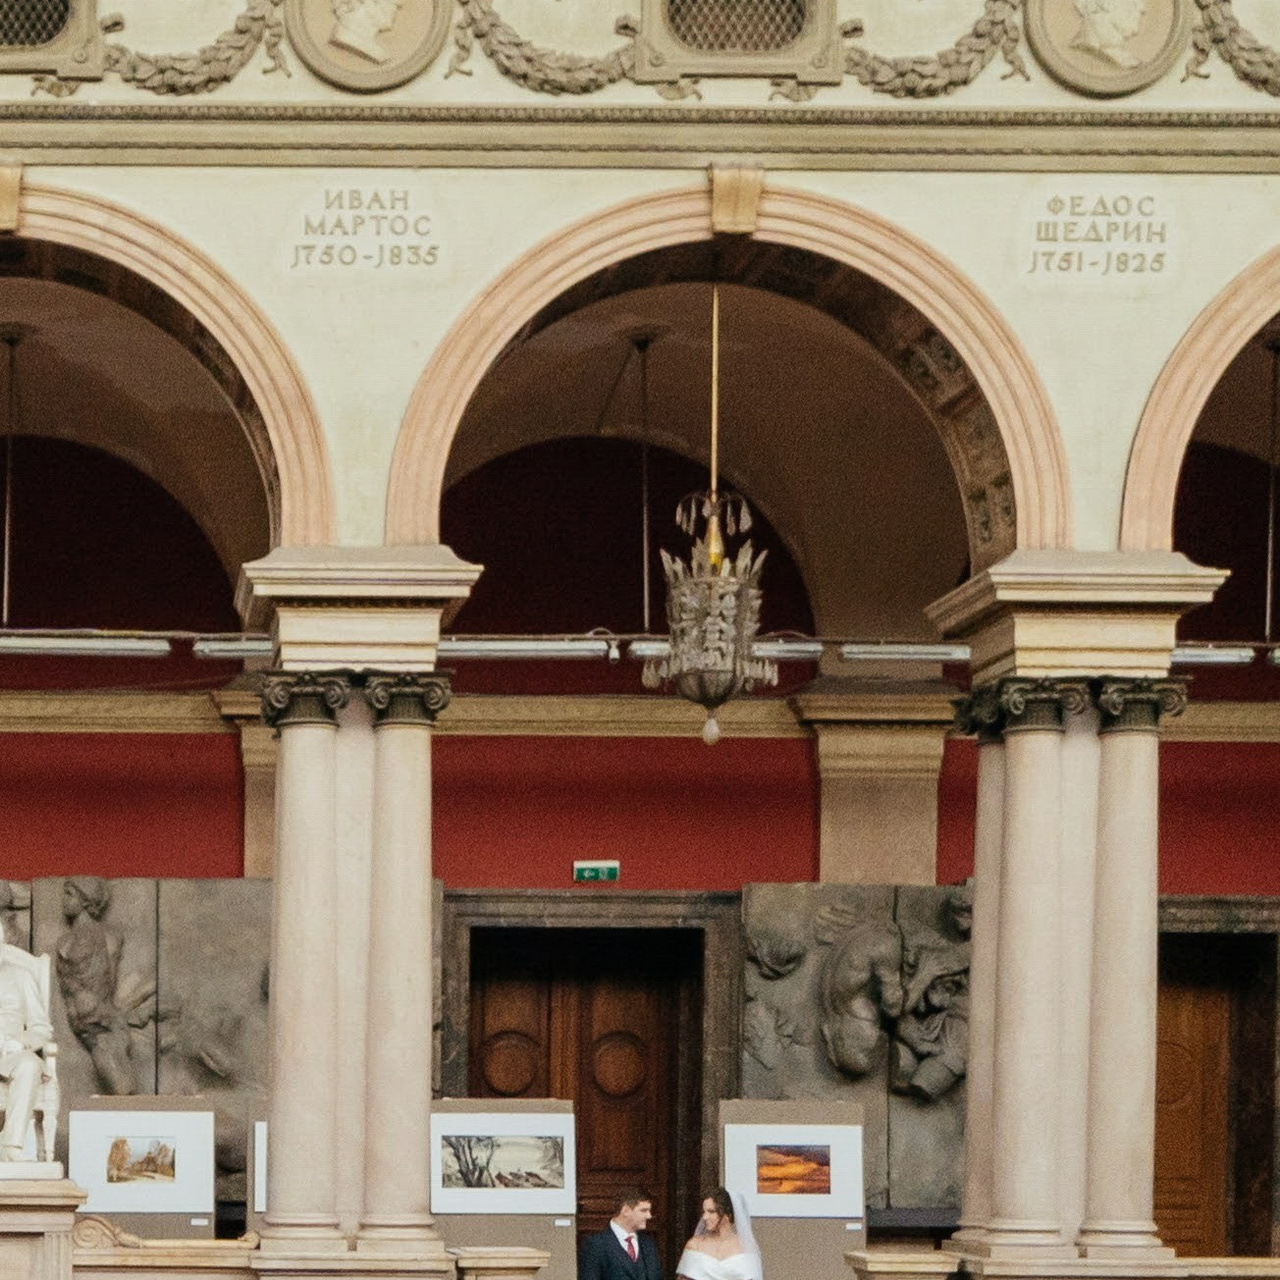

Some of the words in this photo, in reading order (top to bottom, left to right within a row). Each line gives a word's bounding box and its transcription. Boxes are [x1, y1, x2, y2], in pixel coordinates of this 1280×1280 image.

[324, 188, 409, 210] ИВАН
[1046, 194, 1155, 217] ФЕДОС
[303, 214, 431, 237] МАРТОС
